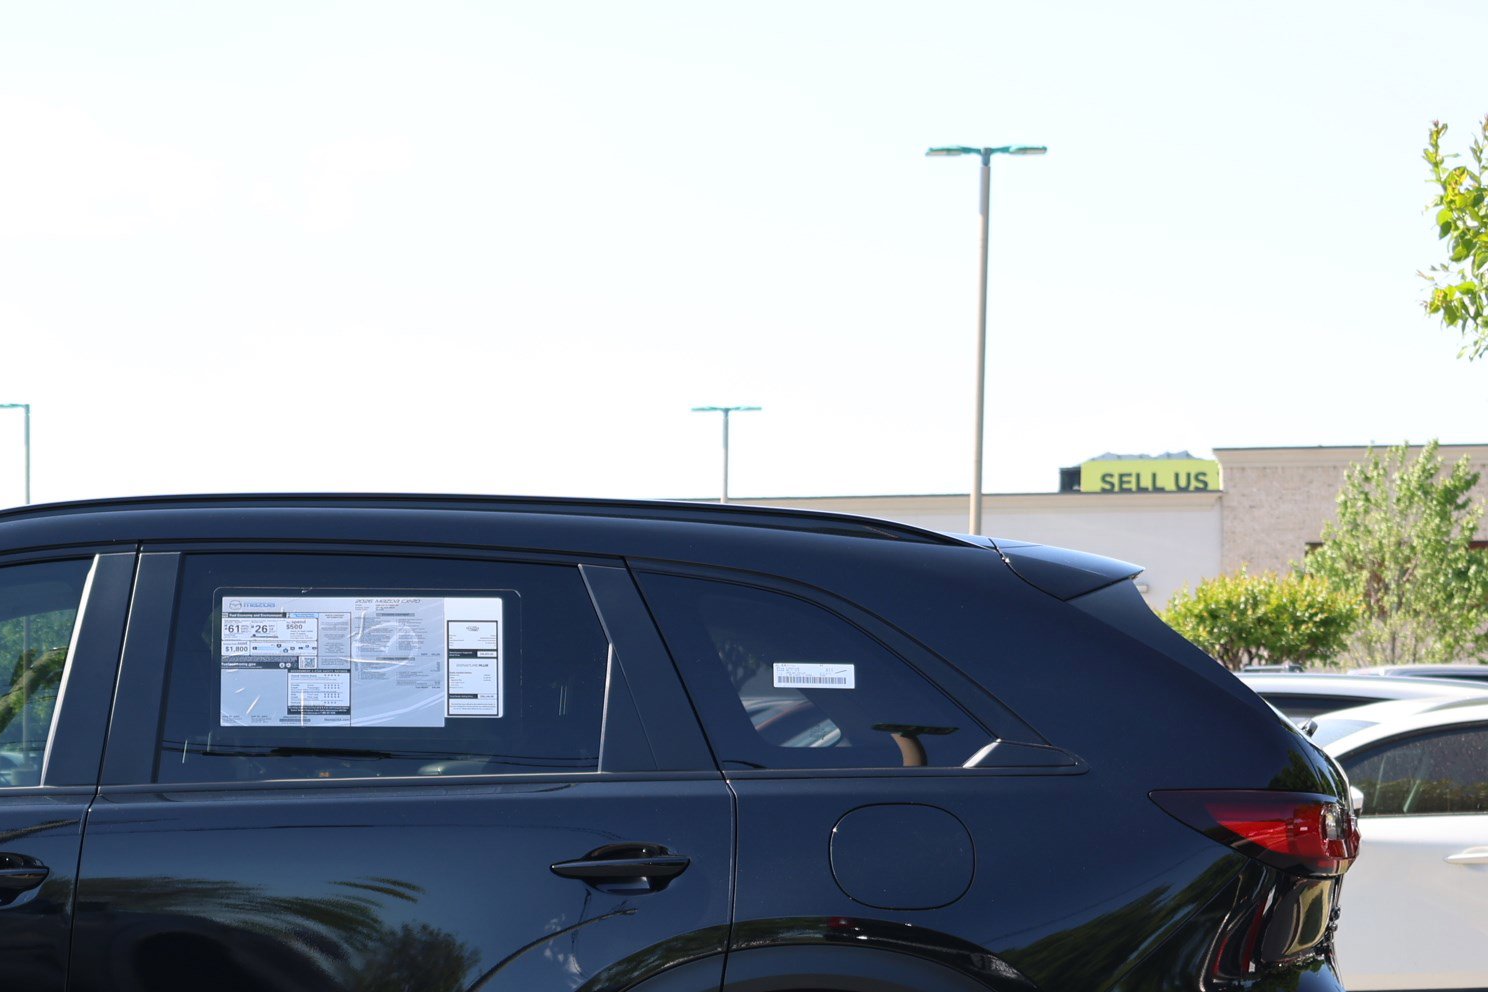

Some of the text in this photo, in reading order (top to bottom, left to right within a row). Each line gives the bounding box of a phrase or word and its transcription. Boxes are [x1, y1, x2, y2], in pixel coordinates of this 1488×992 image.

[1100, 472, 1209, 493] SELL US
[228, 624, 240, 633] 61
[255, 624, 268, 633] 26
